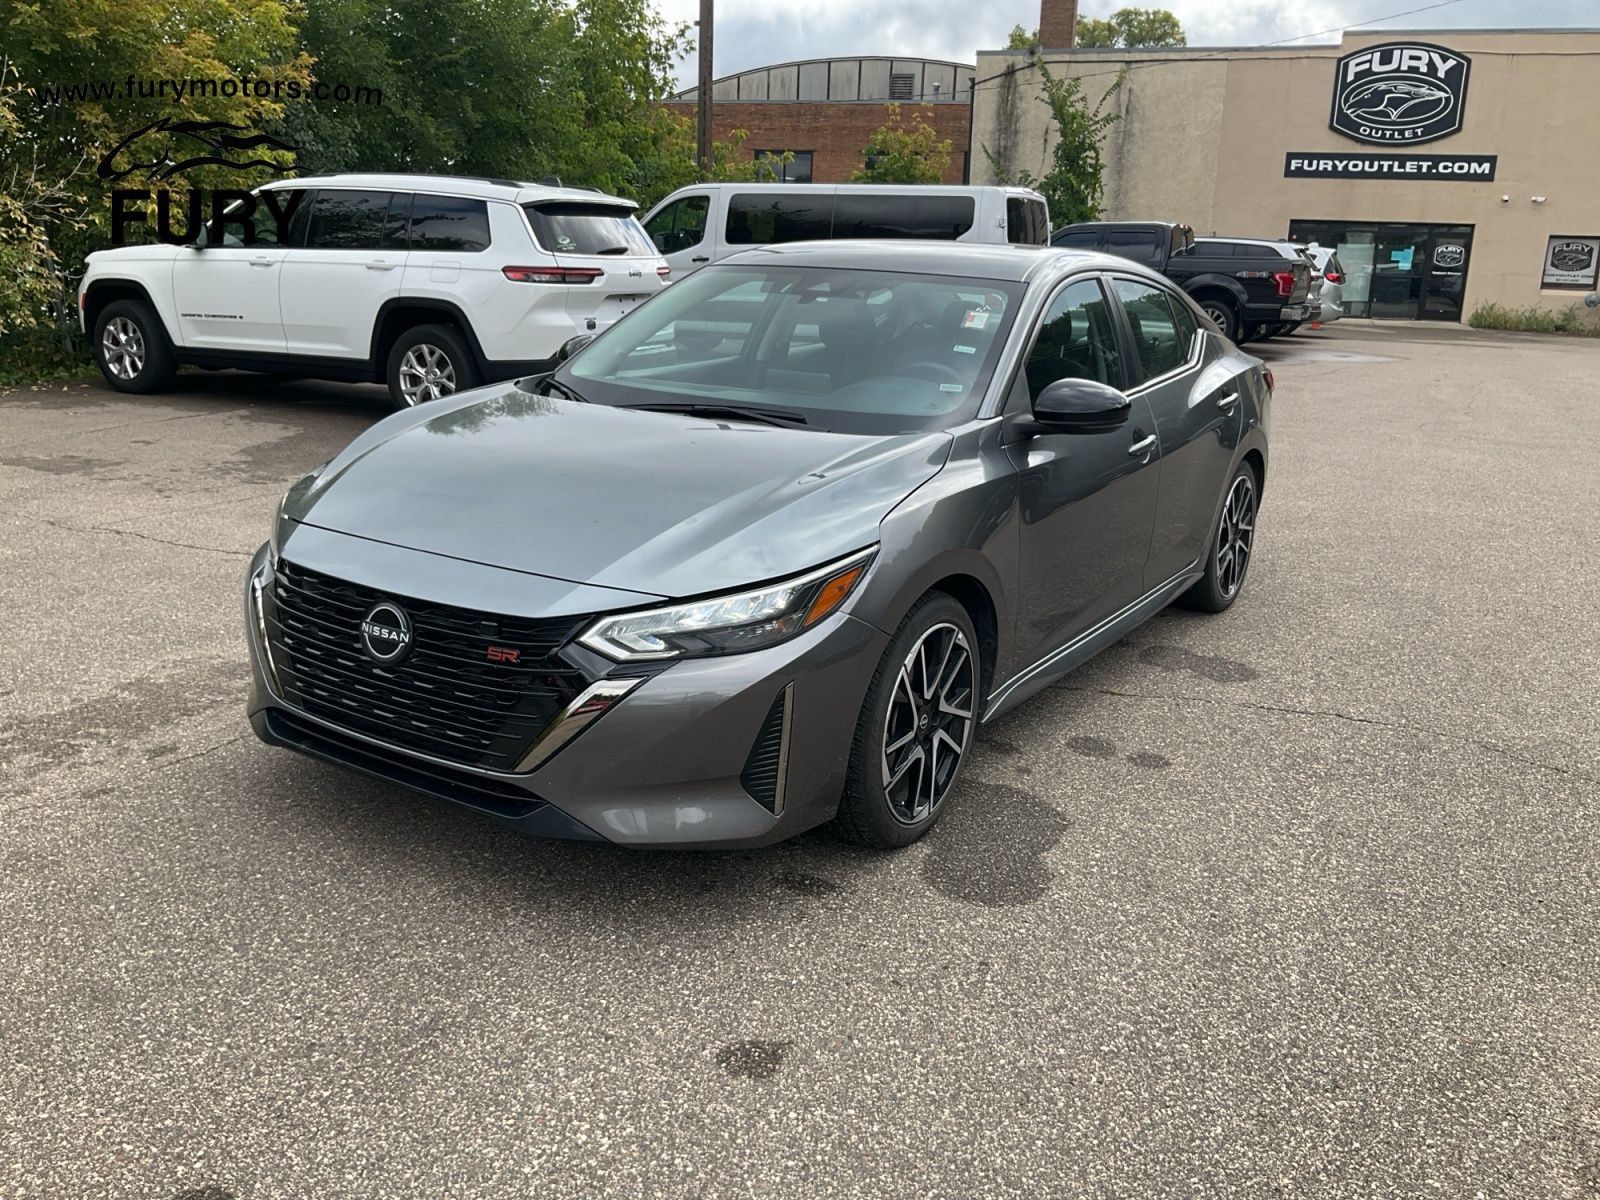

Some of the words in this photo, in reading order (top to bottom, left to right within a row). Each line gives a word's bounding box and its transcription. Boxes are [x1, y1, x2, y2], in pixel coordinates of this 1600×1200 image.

[1347, 49, 1457, 83] FURY
[1359, 126, 1425, 139] OUTLET
[1290, 159, 1491, 174] FURYOUTLET.COM
[1554, 243, 1591, 253] FURY
[362, 622, 409, 643] NISSAN
[487, 646, 520, 663] SR
